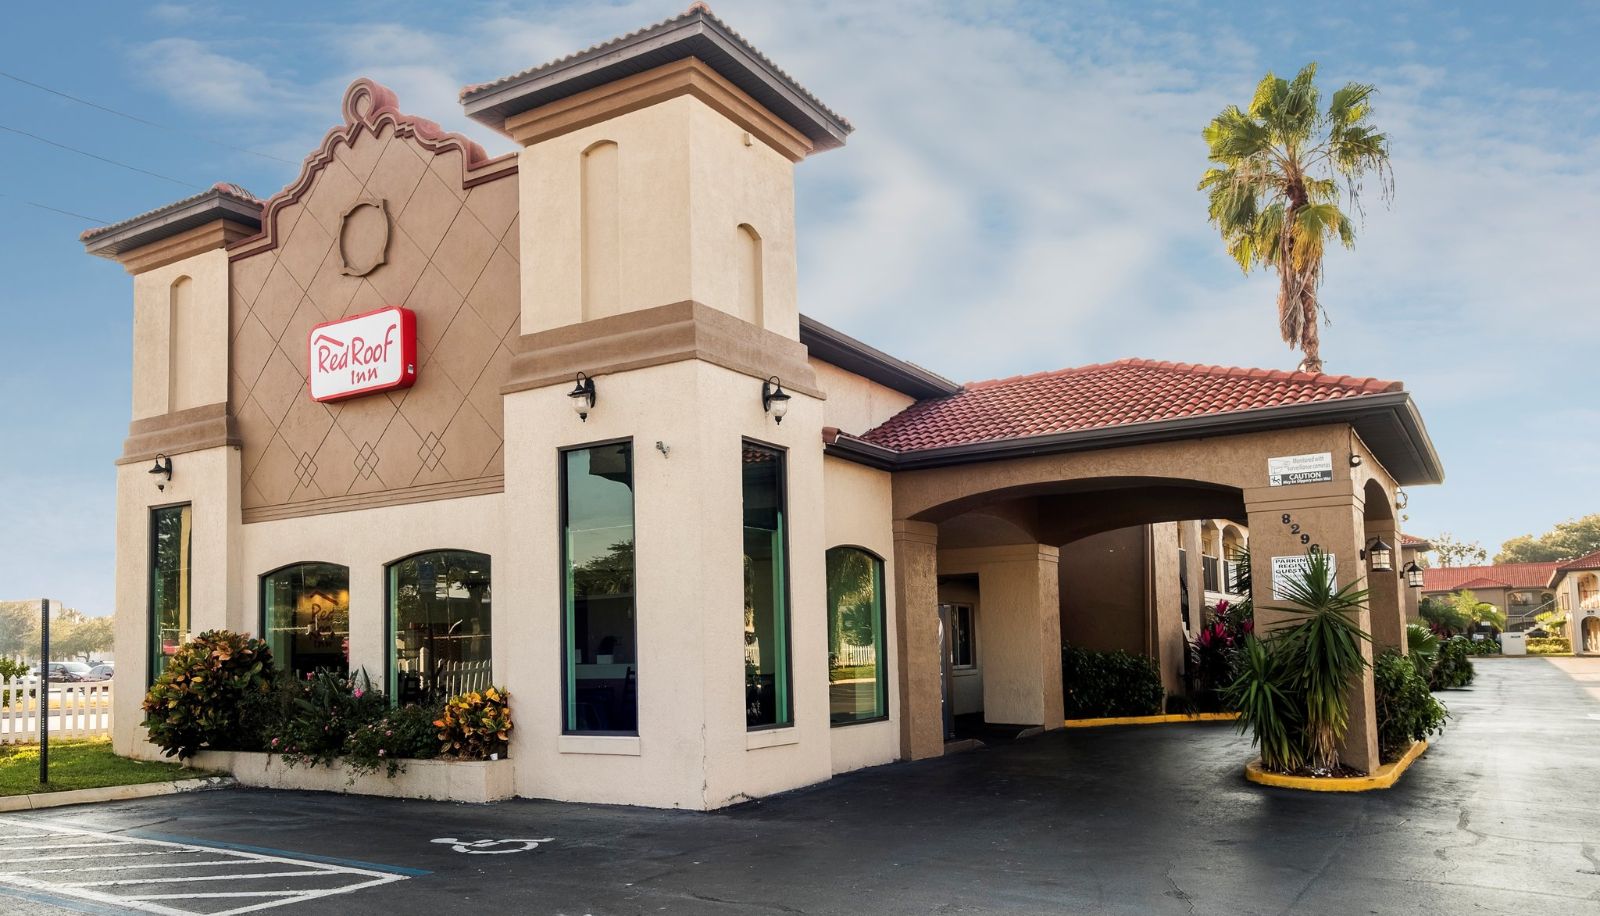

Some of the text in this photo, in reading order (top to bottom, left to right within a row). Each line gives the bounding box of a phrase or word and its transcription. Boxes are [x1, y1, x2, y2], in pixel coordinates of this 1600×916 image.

[318, 323, 397, 374] Red Roof
[350, 366, 378, 385] Inn
[1289, 471, 1322, 481] CAUTION
[1281, 513, 1320, 555] 8296
